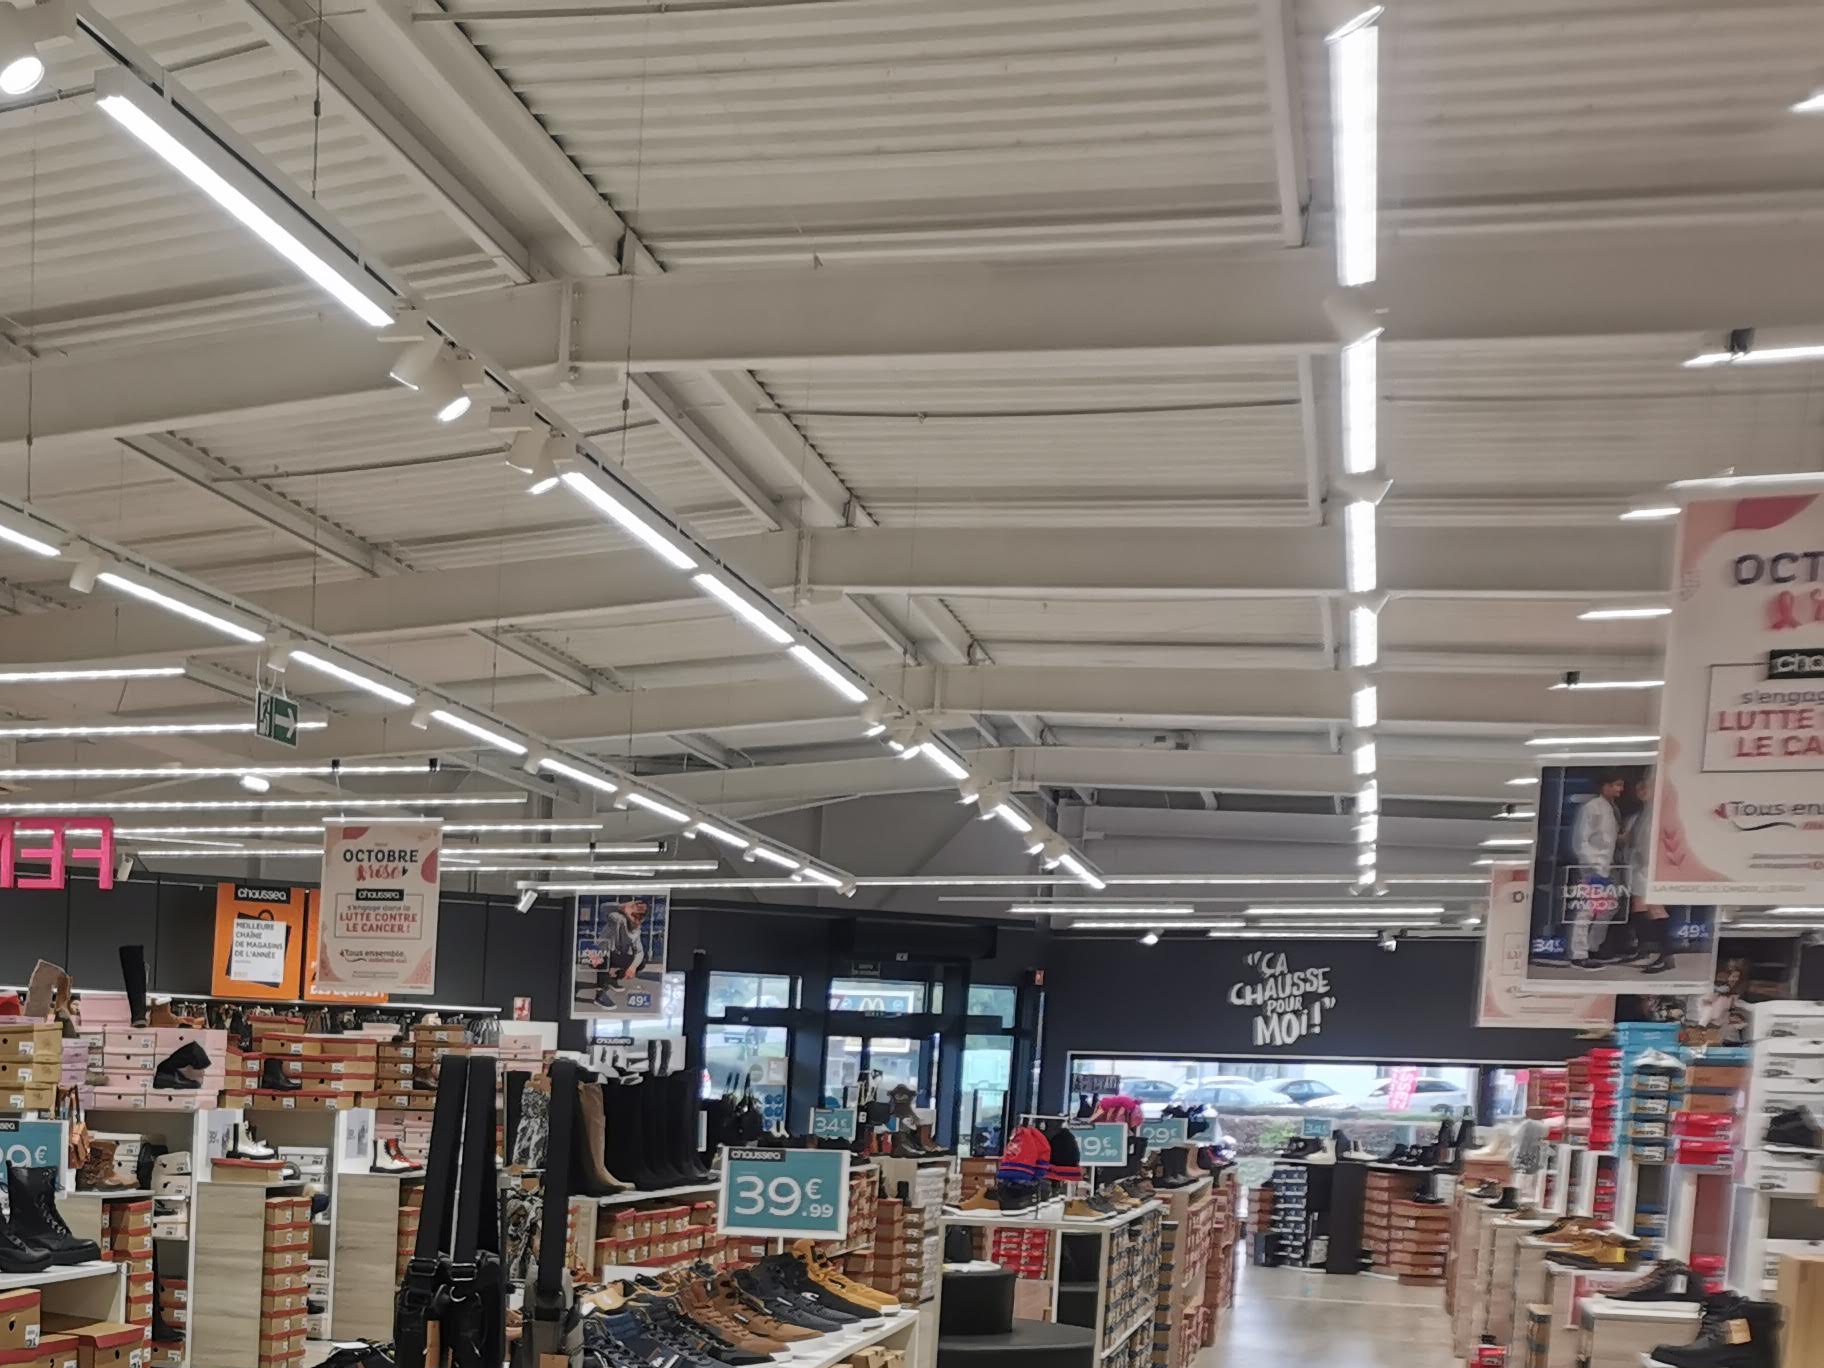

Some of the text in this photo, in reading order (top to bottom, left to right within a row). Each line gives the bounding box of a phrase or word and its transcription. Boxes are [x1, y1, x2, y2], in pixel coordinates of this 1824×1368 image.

[1718, 709, 1815, 731] LUTTE
[1736, 736, 1773, 757] LE
[1728, 801, 1785, 816] Tous
[343, 849, 418, 863] OCTOBRE
[1561, 885, 1631, 898] URBAN
[340, 912, 417, 923] LUTTE CONTRE
[346, 923, 358, 932] LE
[365, 924, 404, 933] CANCER
[1677, 925, 1699, 938] 49
[1533, 939, 1553, 952] 34
[1230, 967, 1330, 1005] CHAUSSE
[628, 997, 643, 1006] 49
[1267, 996, 1303, 1016] POUR
[815, 1116, 840, 1133] 34
[1143, 1126, 1170, 1143] 29
[735, 1176, 801, 1216] 39
[805, 1178, 823, 1199] €
